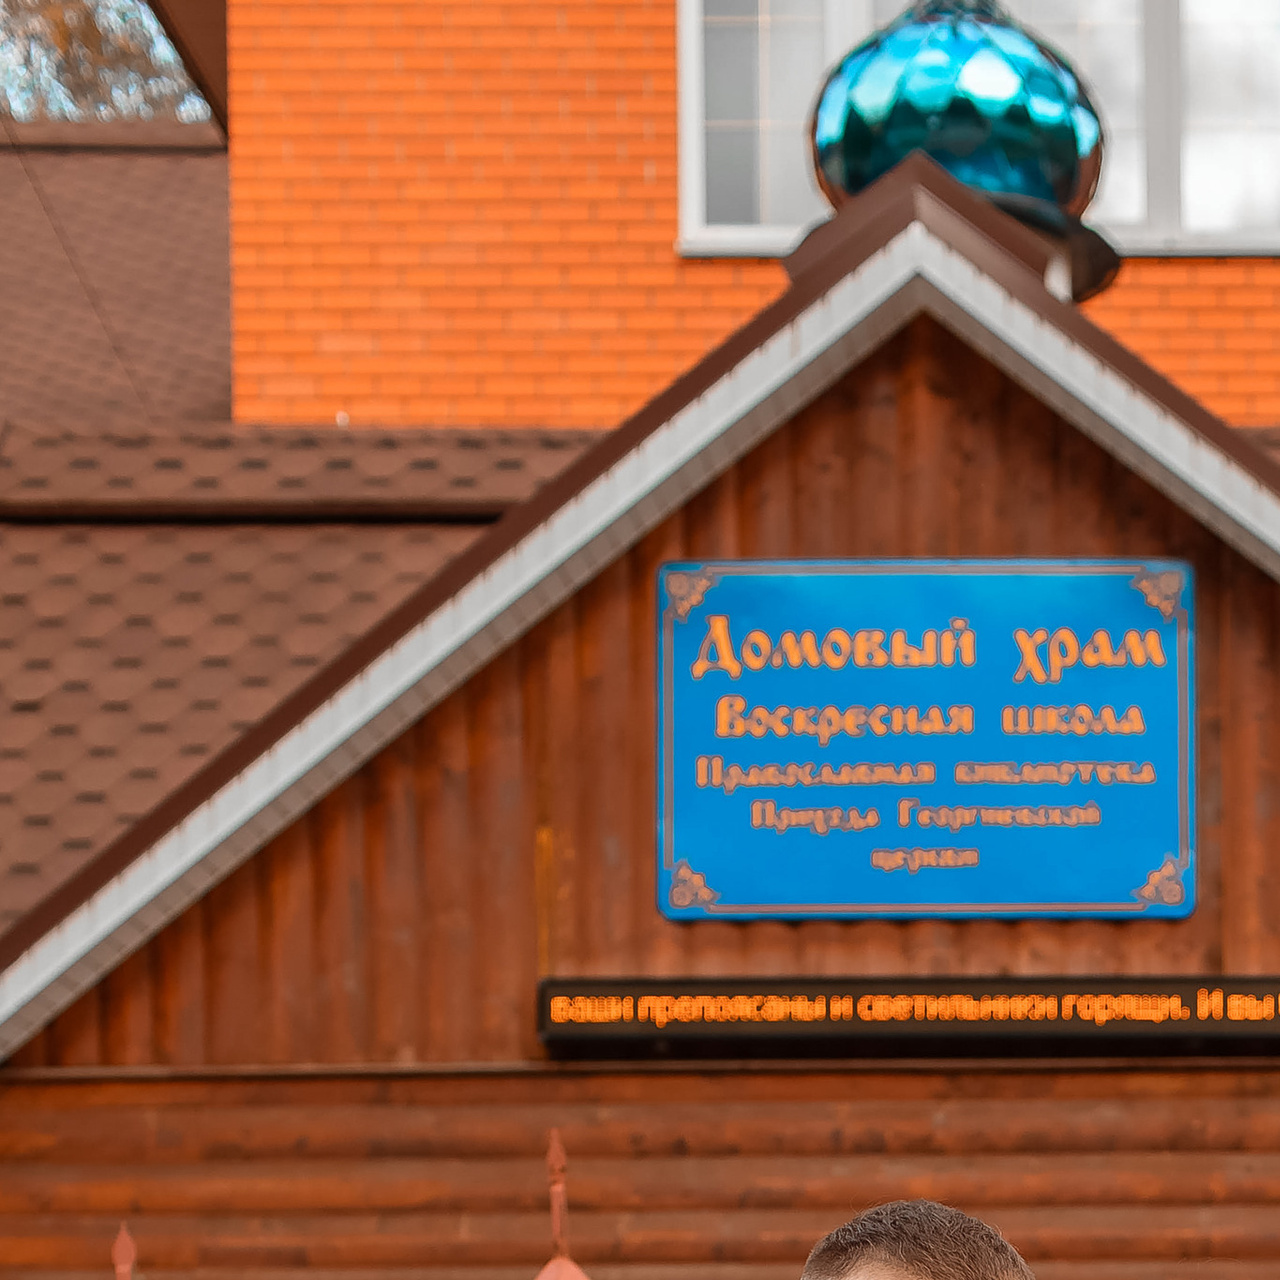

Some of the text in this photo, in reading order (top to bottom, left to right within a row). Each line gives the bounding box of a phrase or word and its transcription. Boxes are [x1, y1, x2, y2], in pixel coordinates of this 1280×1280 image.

[691, 614, 1167, 684] Домовый храм
[716, 695, 1146, 747] Воскресная школа
[1196, 988, 1224, 1021] И
